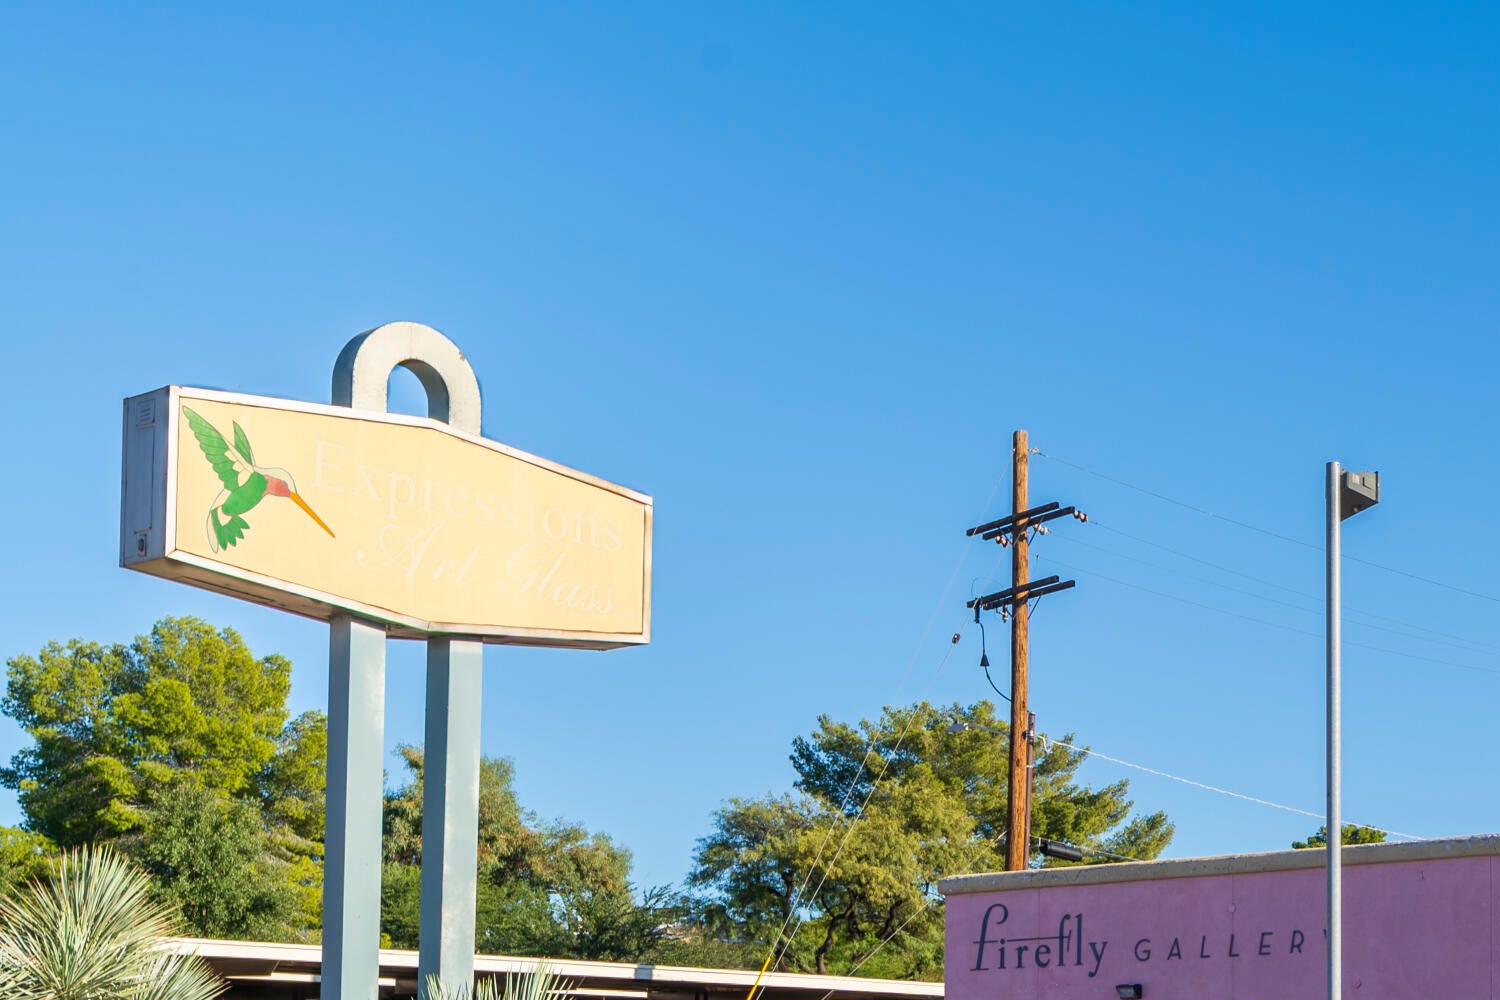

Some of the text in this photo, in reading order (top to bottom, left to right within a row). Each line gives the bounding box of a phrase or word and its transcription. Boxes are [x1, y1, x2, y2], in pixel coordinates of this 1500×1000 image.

[314, 439, 623, 552] Expressions
[355, 520, 618, 616] Art Glass
[1133, 928, 1328, 963] GALLER
